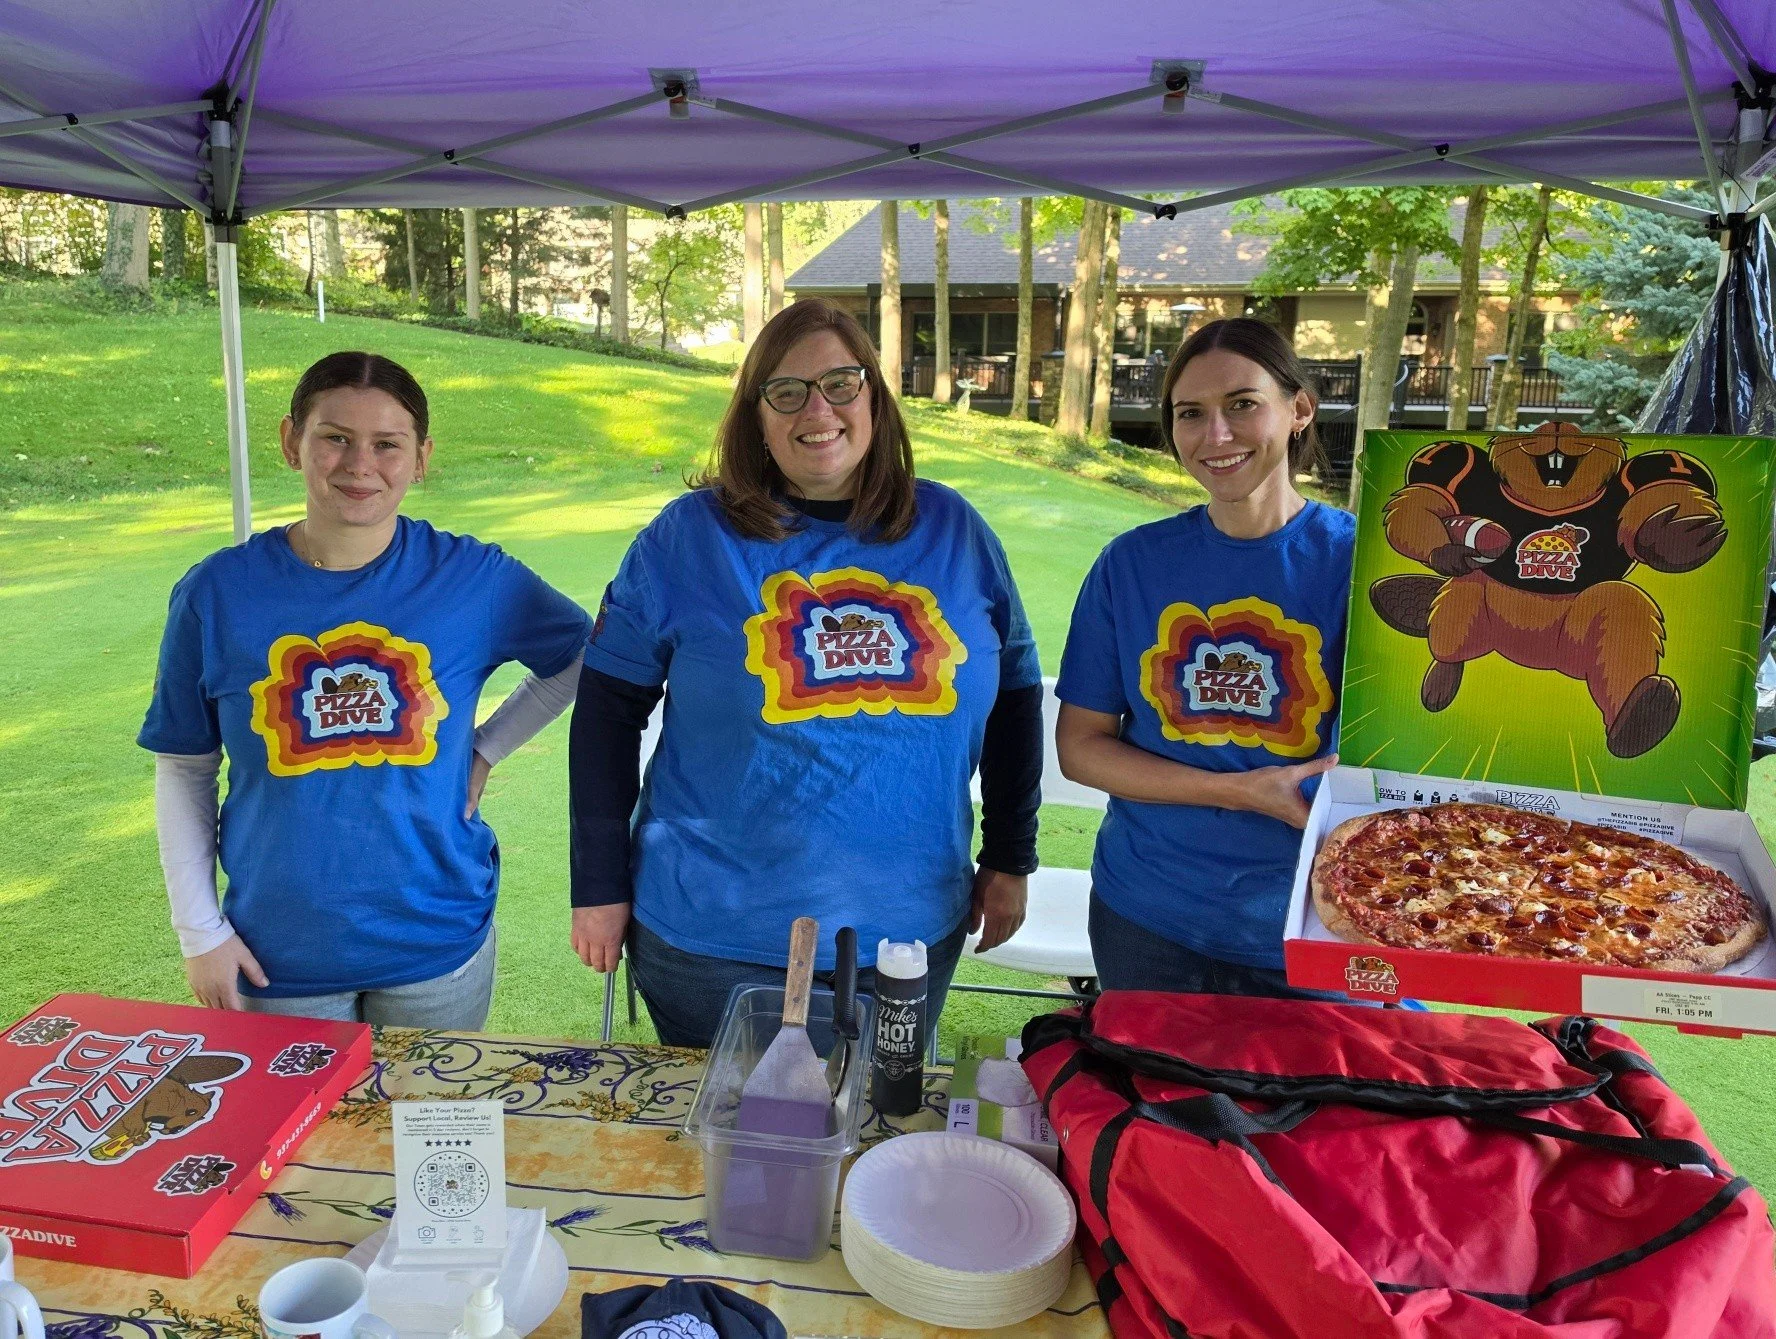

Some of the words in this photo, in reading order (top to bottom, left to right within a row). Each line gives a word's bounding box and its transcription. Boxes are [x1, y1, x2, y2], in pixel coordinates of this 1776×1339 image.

[1518, 549, 1579, 567] PIZZA
[1521, 564, 1574, 579] DIVE
[815, 629, 896, 651] PIZZA
[823, 648, 893, 670] DIVE
[1194, 669, 1268, 691] PIZZA
[313, 690, 387, 713] PIZZA
[1199, 686, 1262, 708] DIVE
[319, 707, 383, 730] DIVE
[1495, 789, 1561, 811] PIZZA
[1610, 812, 1648, 822] MENTION
[1345, 968, 1399, 984] PIZZA
[1350, 980, 1396, 995] DIVE
[878, 1004, 918, 1024] Mike's
[1655, 1006, 1673, 1016] FRI,
[1677, 1008, 1696, 1017] 1:05
[1698, 1009, 1713, 1018] PM
[877, 1017, 917, 1043] HOT
[877, 1036, 915, 1054] HONEY
[2, 1033, 197, 1162] PIZZA
[961, 1103, 971, 1115] 100
[1040, 1122, 1049, 1142] CLEAR
[0, 1225, 77, 1248] ZZADIVE
